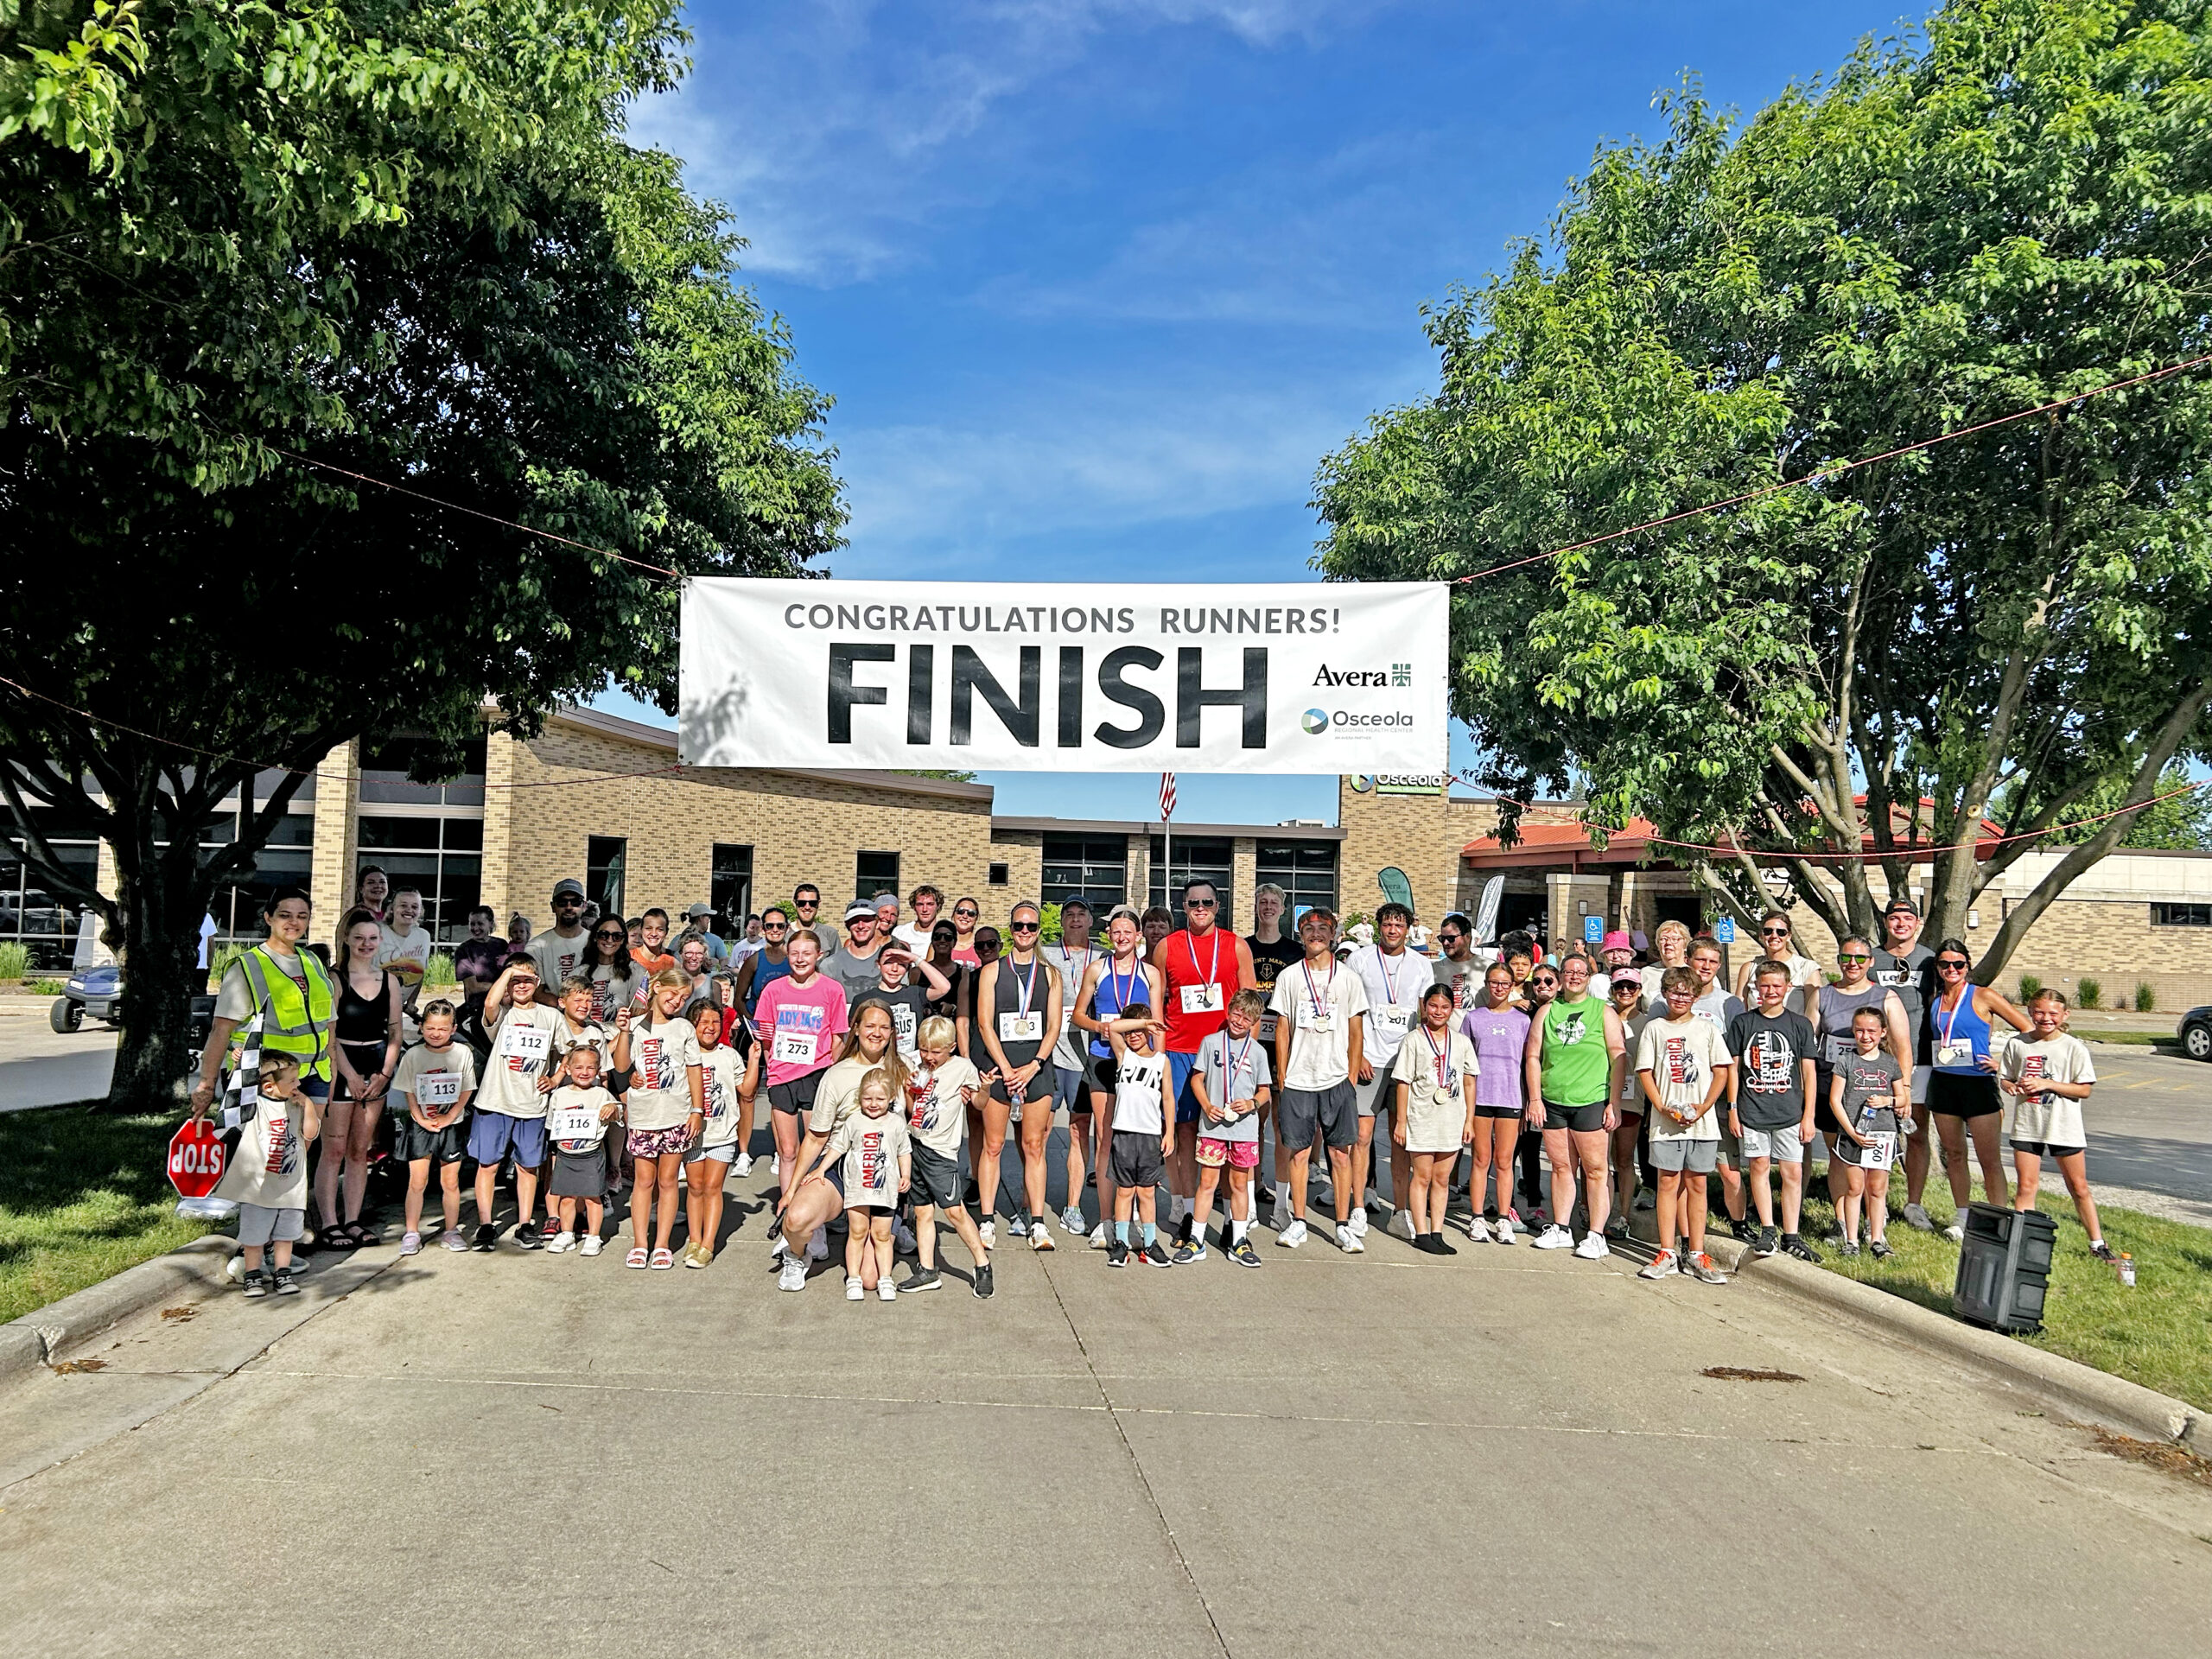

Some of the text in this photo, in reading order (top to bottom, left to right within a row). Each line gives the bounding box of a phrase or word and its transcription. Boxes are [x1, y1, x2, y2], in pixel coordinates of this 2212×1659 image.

[785, 603, 1340, 634] CONGRATULATIONS RUNNERS!
[1312, 663, 1388, 687] Avera
[827, 642, 1268, 750] FINISH
[1332, 710, 1413, 727] Osceola
[1268, 957, 1287, 968] MART
[778, 1011, 798, 1026] ADY
[1312, 1010, 1332, 1020] 26
[894, 1019, 912, 1035] SUS
[1262, 1023, 1277, 1033] 25
[520, 1036, 543, 1049] 112
[787, 1043, 809, 1055] 273
[1838, 1046, 1854, 1056] 25
[643, 1038, 660, 1090] AMERICA
[1666, 1037, 1686, 1084] AMERICA
[434, 1084, 456, 1096] 113
[569, 1118, 591, 1128] 116
[264, 1118, 288, 1174] AMERICA
[1872, 1143, 1885, 1162] 260
[171, 1143, 222, 1175] STOP
[861, 1132, 880, 1189] AMERICA
